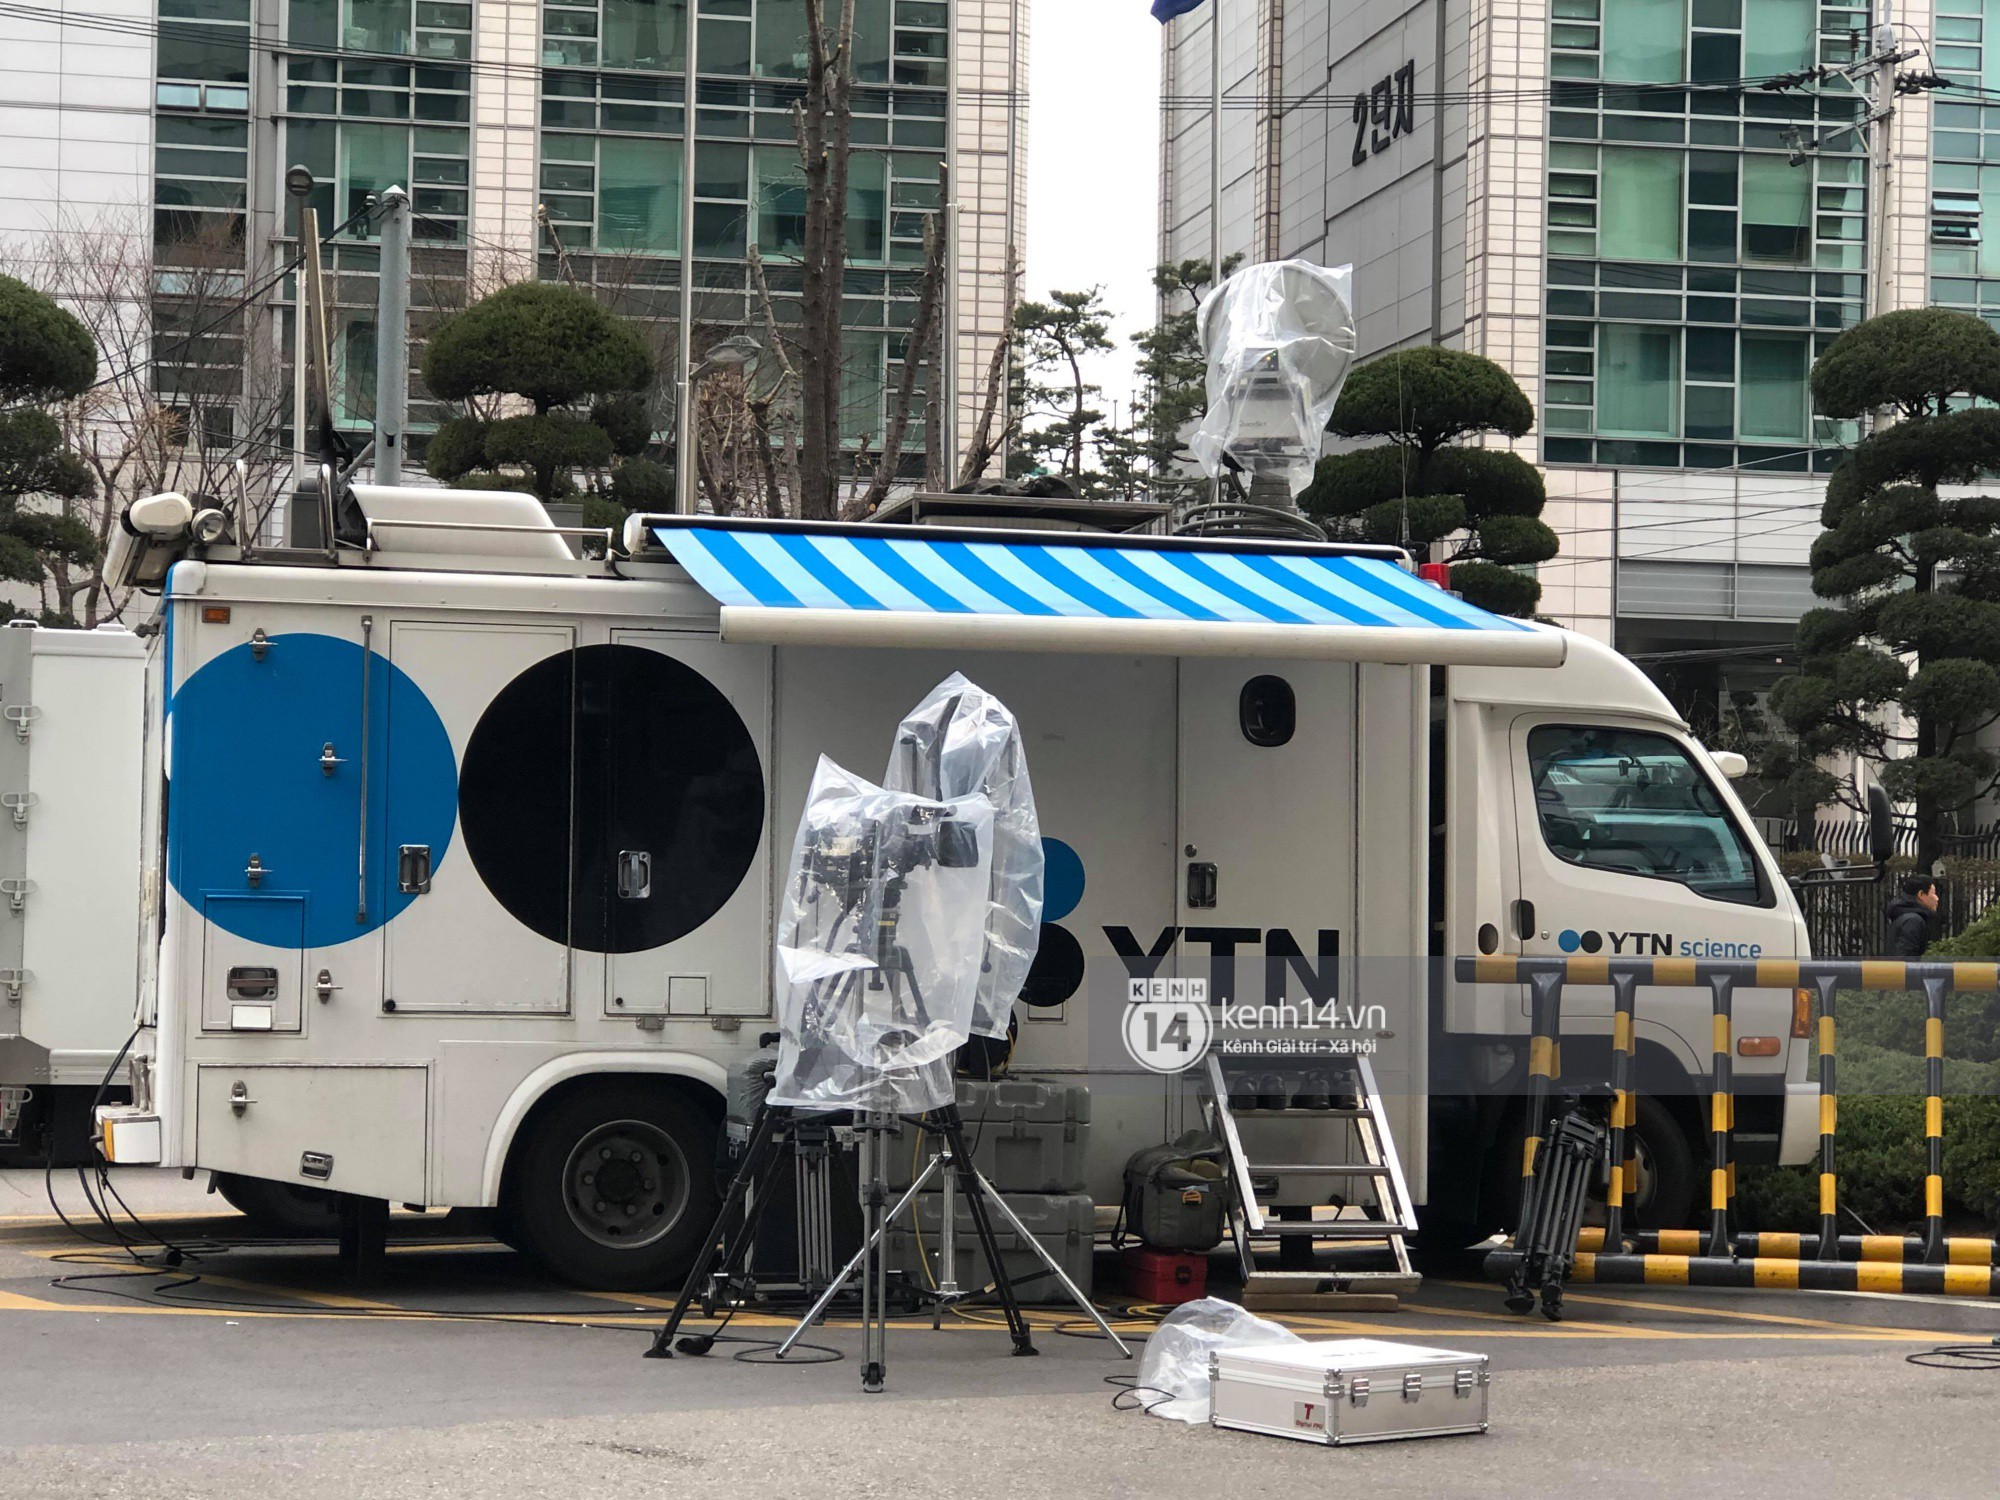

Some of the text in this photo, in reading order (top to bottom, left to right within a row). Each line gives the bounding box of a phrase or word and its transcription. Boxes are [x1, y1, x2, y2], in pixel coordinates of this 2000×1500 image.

[1352, 58, 1415, 166] 2단지
[1102, 926, 1340, 1007] YTN
[1607, 931, 1762, 959] YTN science
[1304, 1403, 1314, 1420] T
